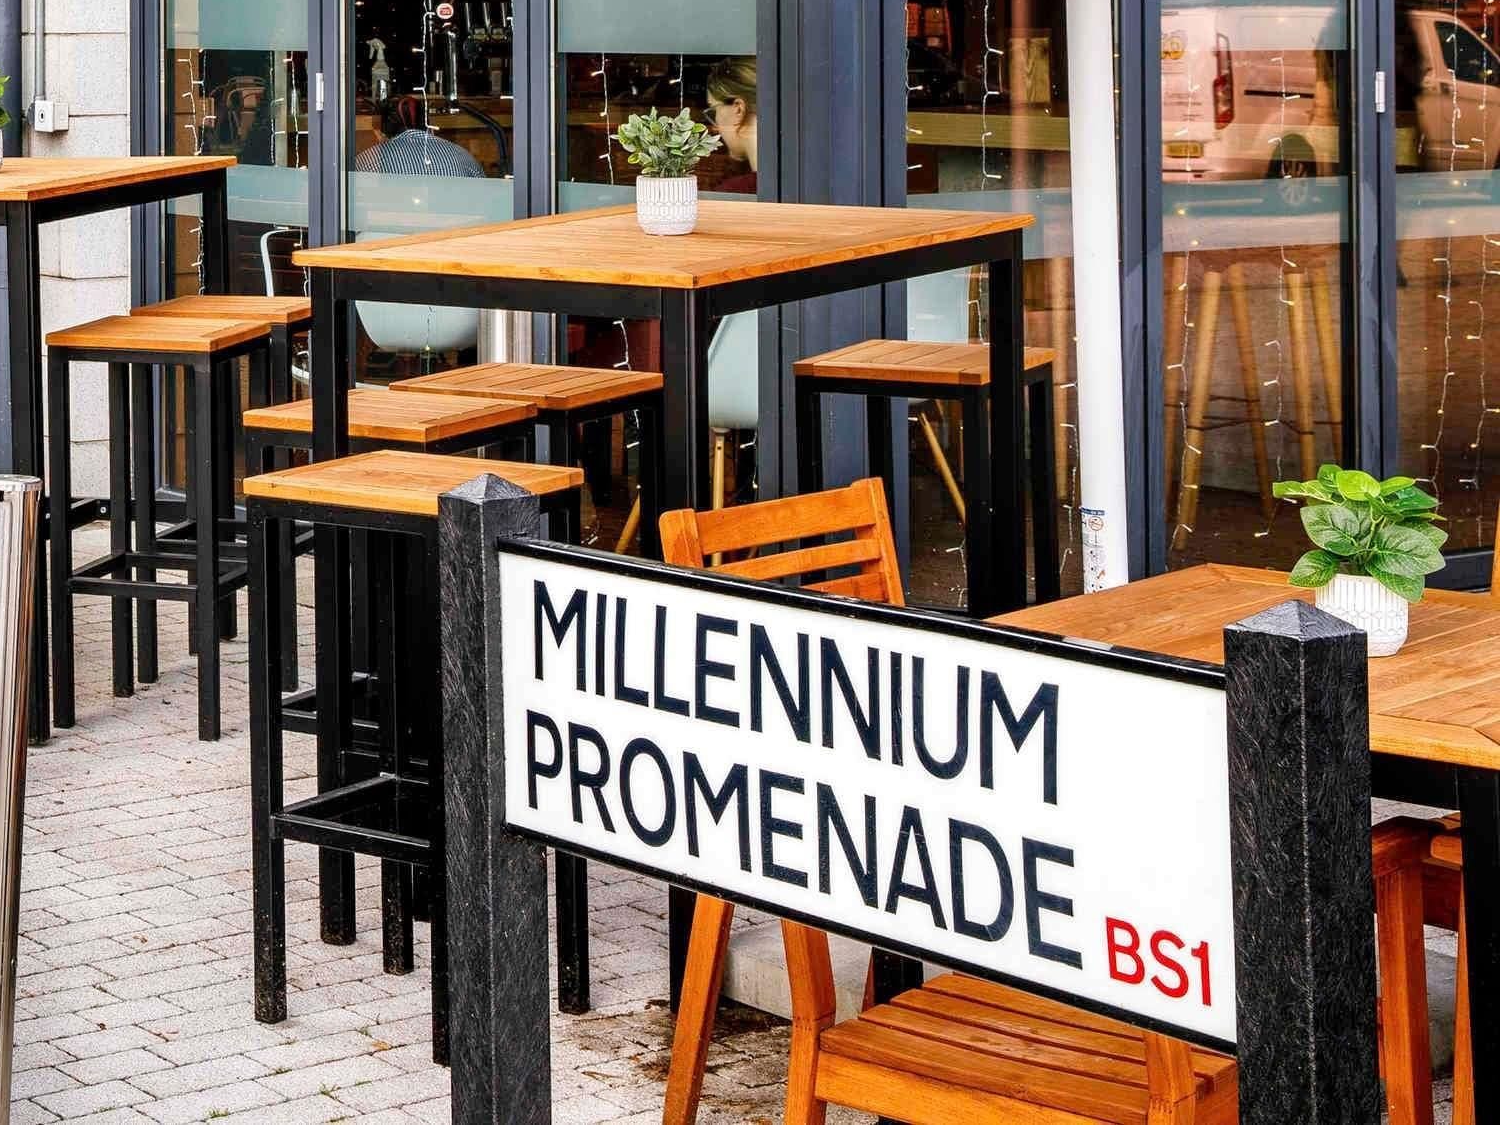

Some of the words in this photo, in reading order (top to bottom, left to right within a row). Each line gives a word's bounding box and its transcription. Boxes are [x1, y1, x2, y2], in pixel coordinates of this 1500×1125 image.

[533, 579, 1058, 806] MILLENNIUM
[527, 709, 1084, 971] PROMENADE
[1105, 915, 1212, 1007] BS1
